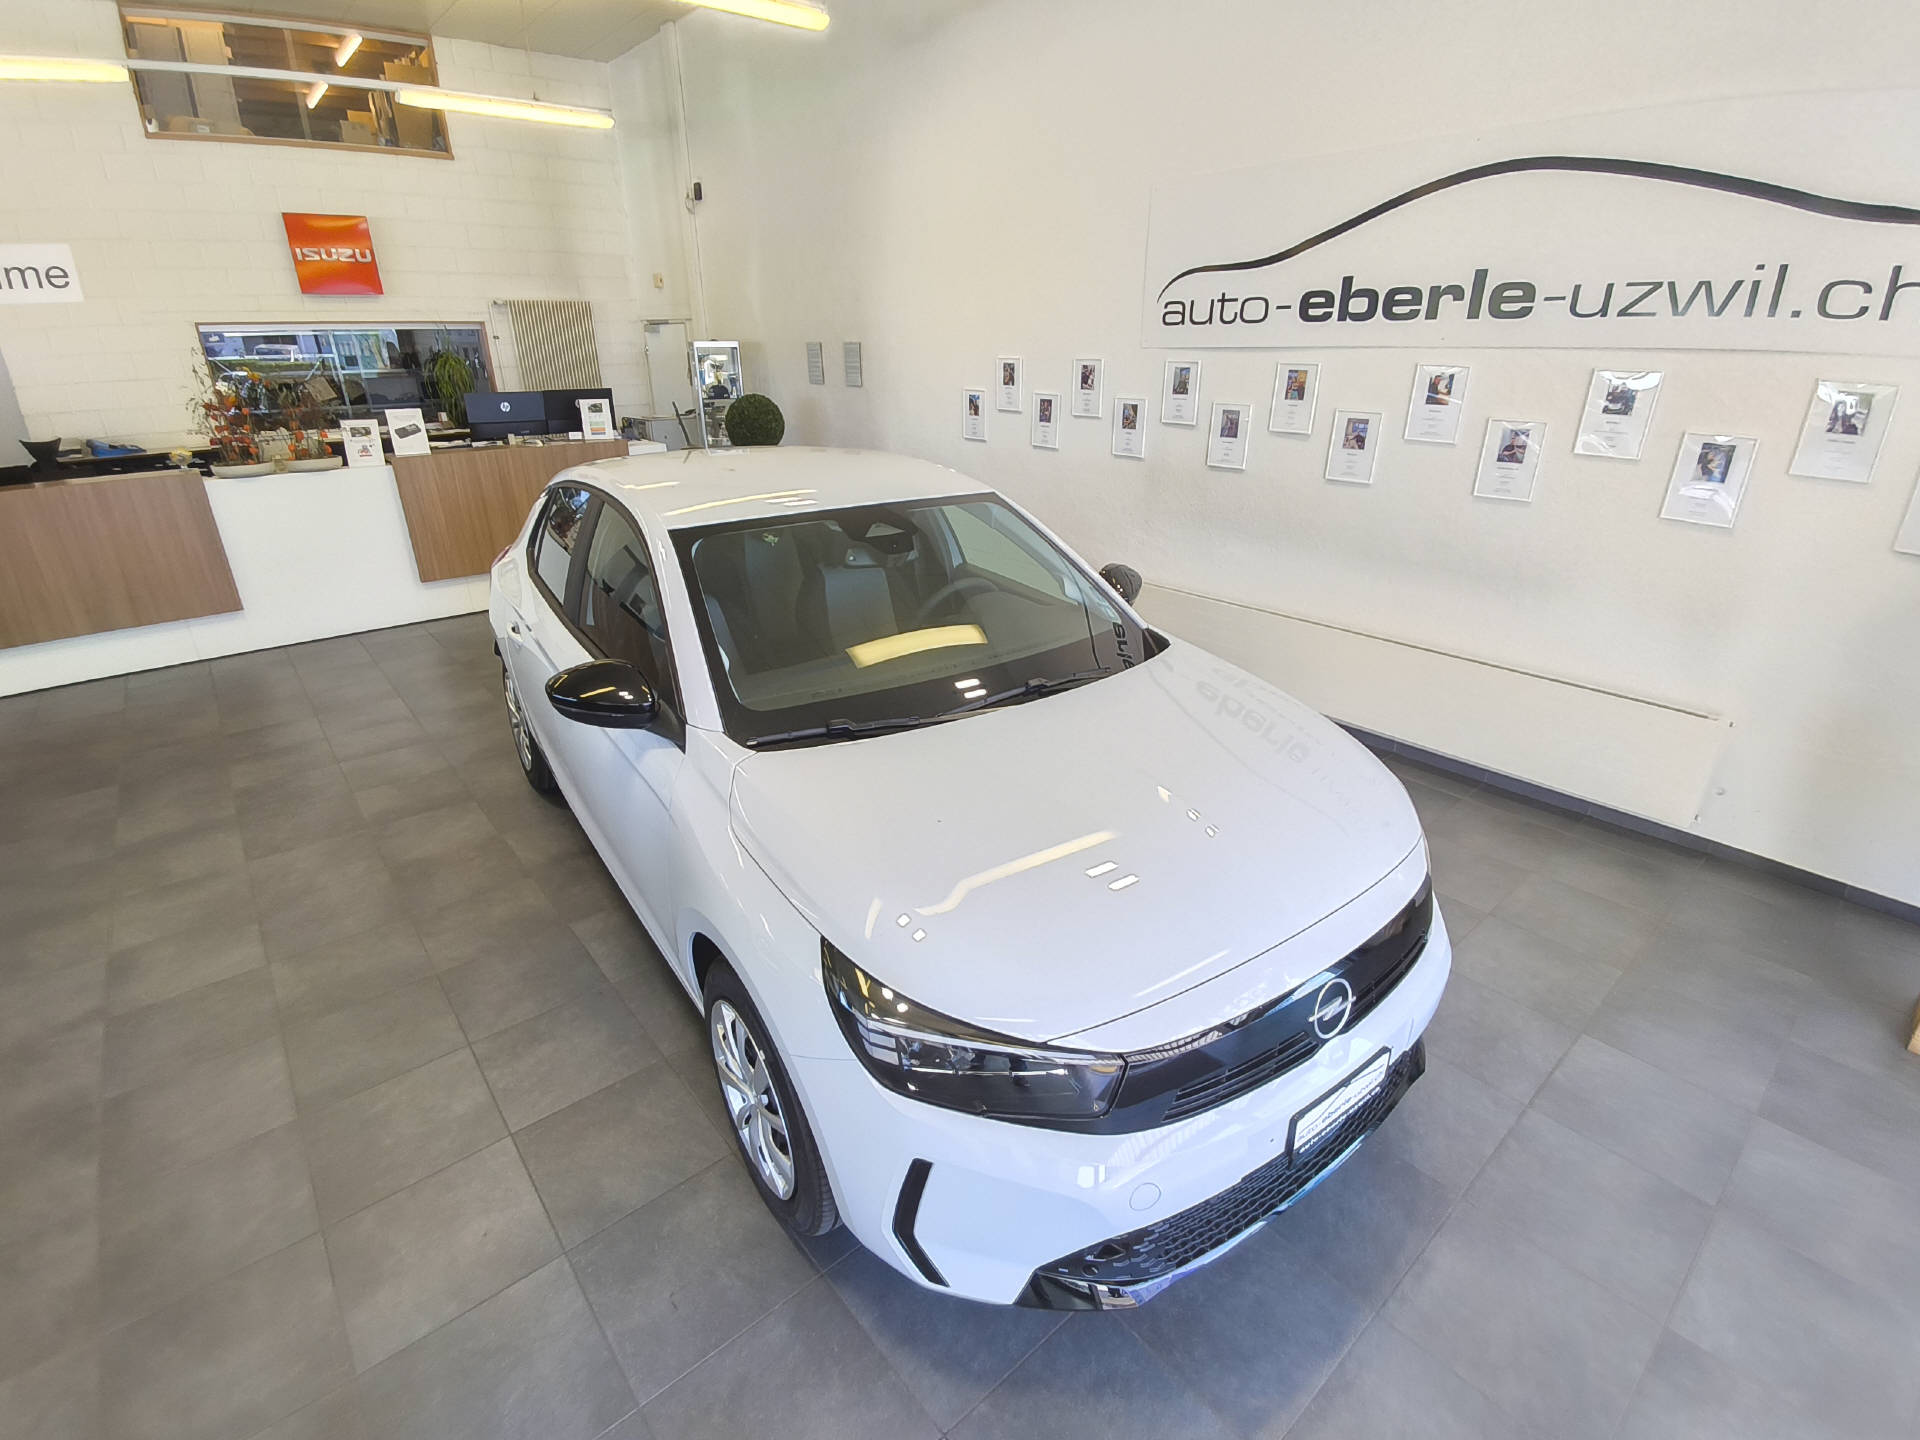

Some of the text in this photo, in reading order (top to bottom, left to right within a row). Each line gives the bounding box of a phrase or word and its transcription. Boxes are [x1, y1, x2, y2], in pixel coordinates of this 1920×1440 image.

[294, 247, 372, 263] ISUZU
[0, 265, 70, 290] me
[1161, 264, 1920, 326] auto-eberle-uzwil.ch
